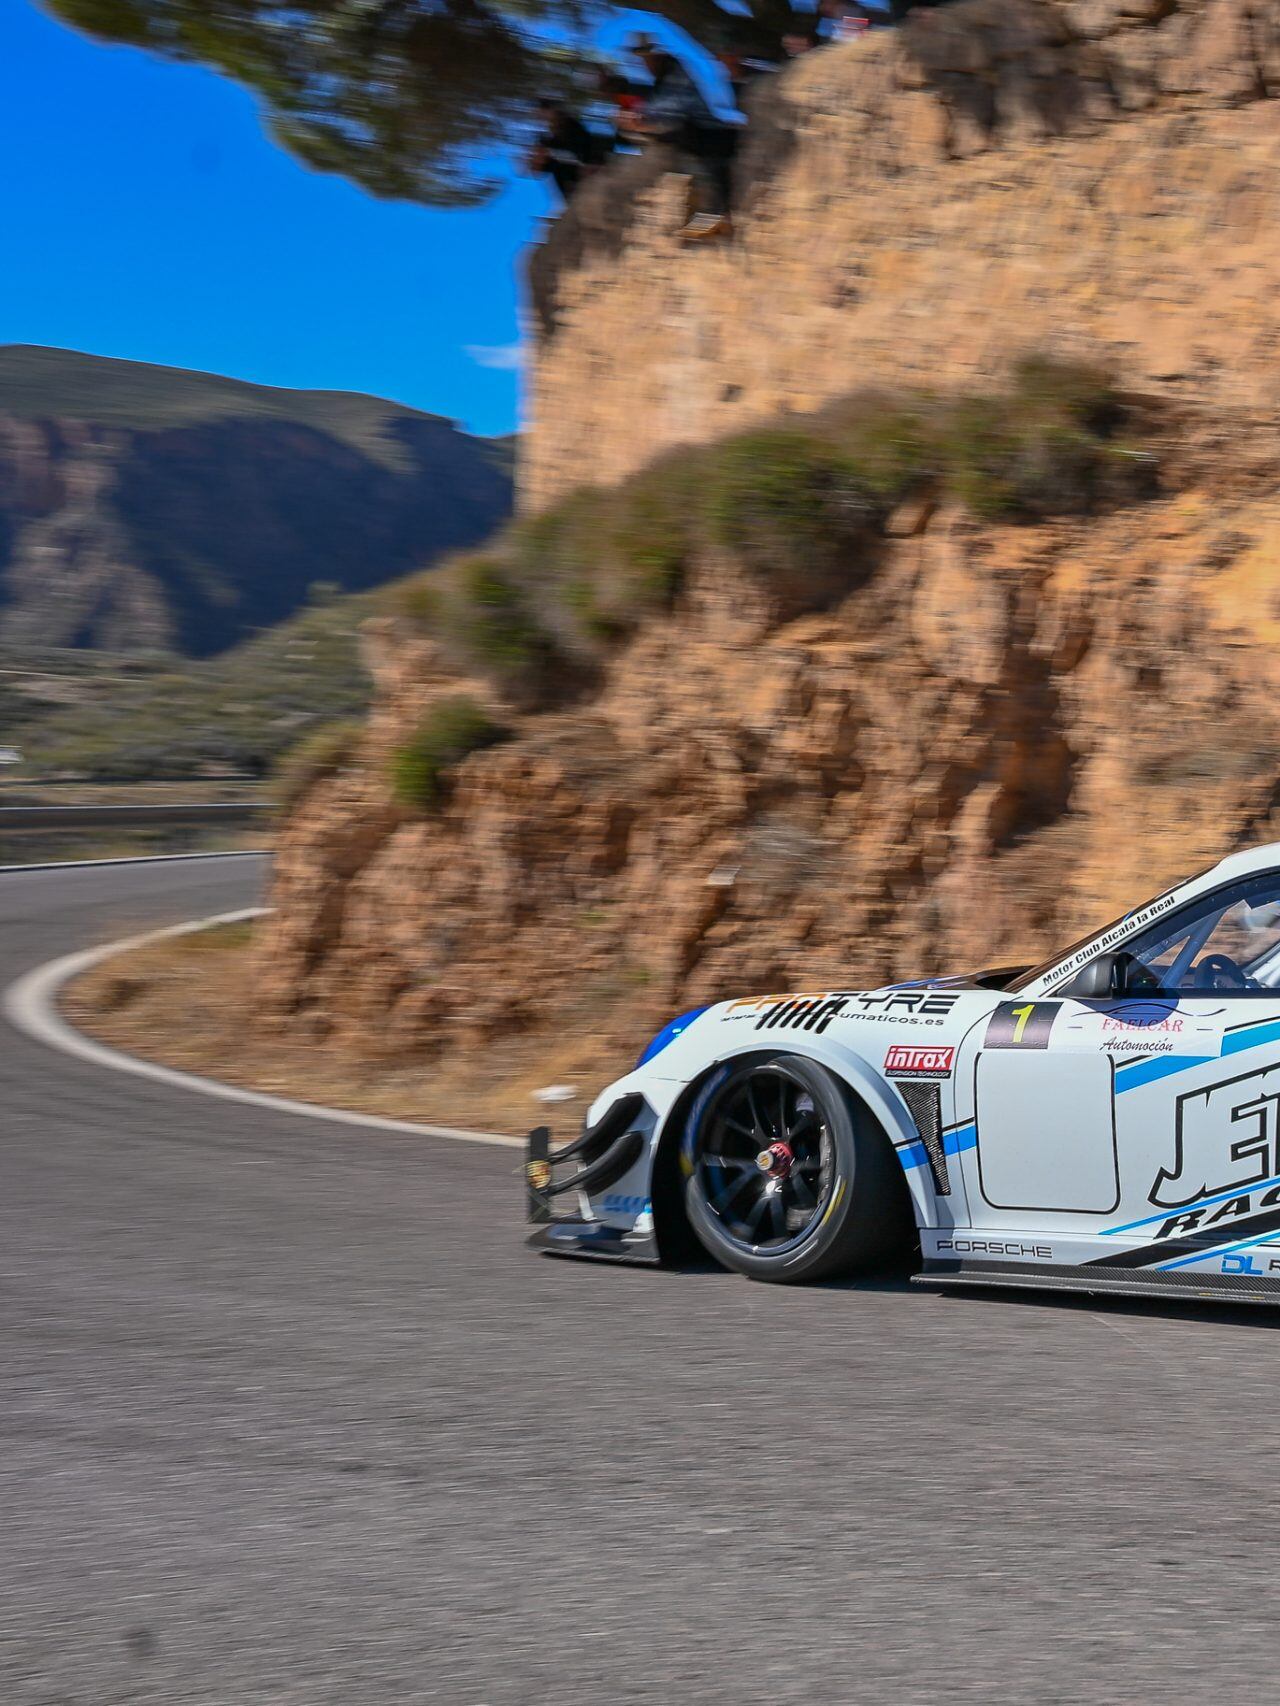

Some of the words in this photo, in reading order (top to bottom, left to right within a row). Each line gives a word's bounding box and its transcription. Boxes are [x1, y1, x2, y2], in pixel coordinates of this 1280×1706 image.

[1042, 959, 1075, 987] Motor
[1075, 943, 1101, 965] Club
[1136, 911, 1149, 925] la
[1149, 895, 1176, 917] Real
[1011, 1004, 1036, 1044] 1
[1102, 1018, 1184, 1033] FAELCAR
[1099, 1036, 1174, 1051] Automoción
[936, 1240, 1053, 1259] PORSCHE
[1220, 1253, 1264, 1276] DL
